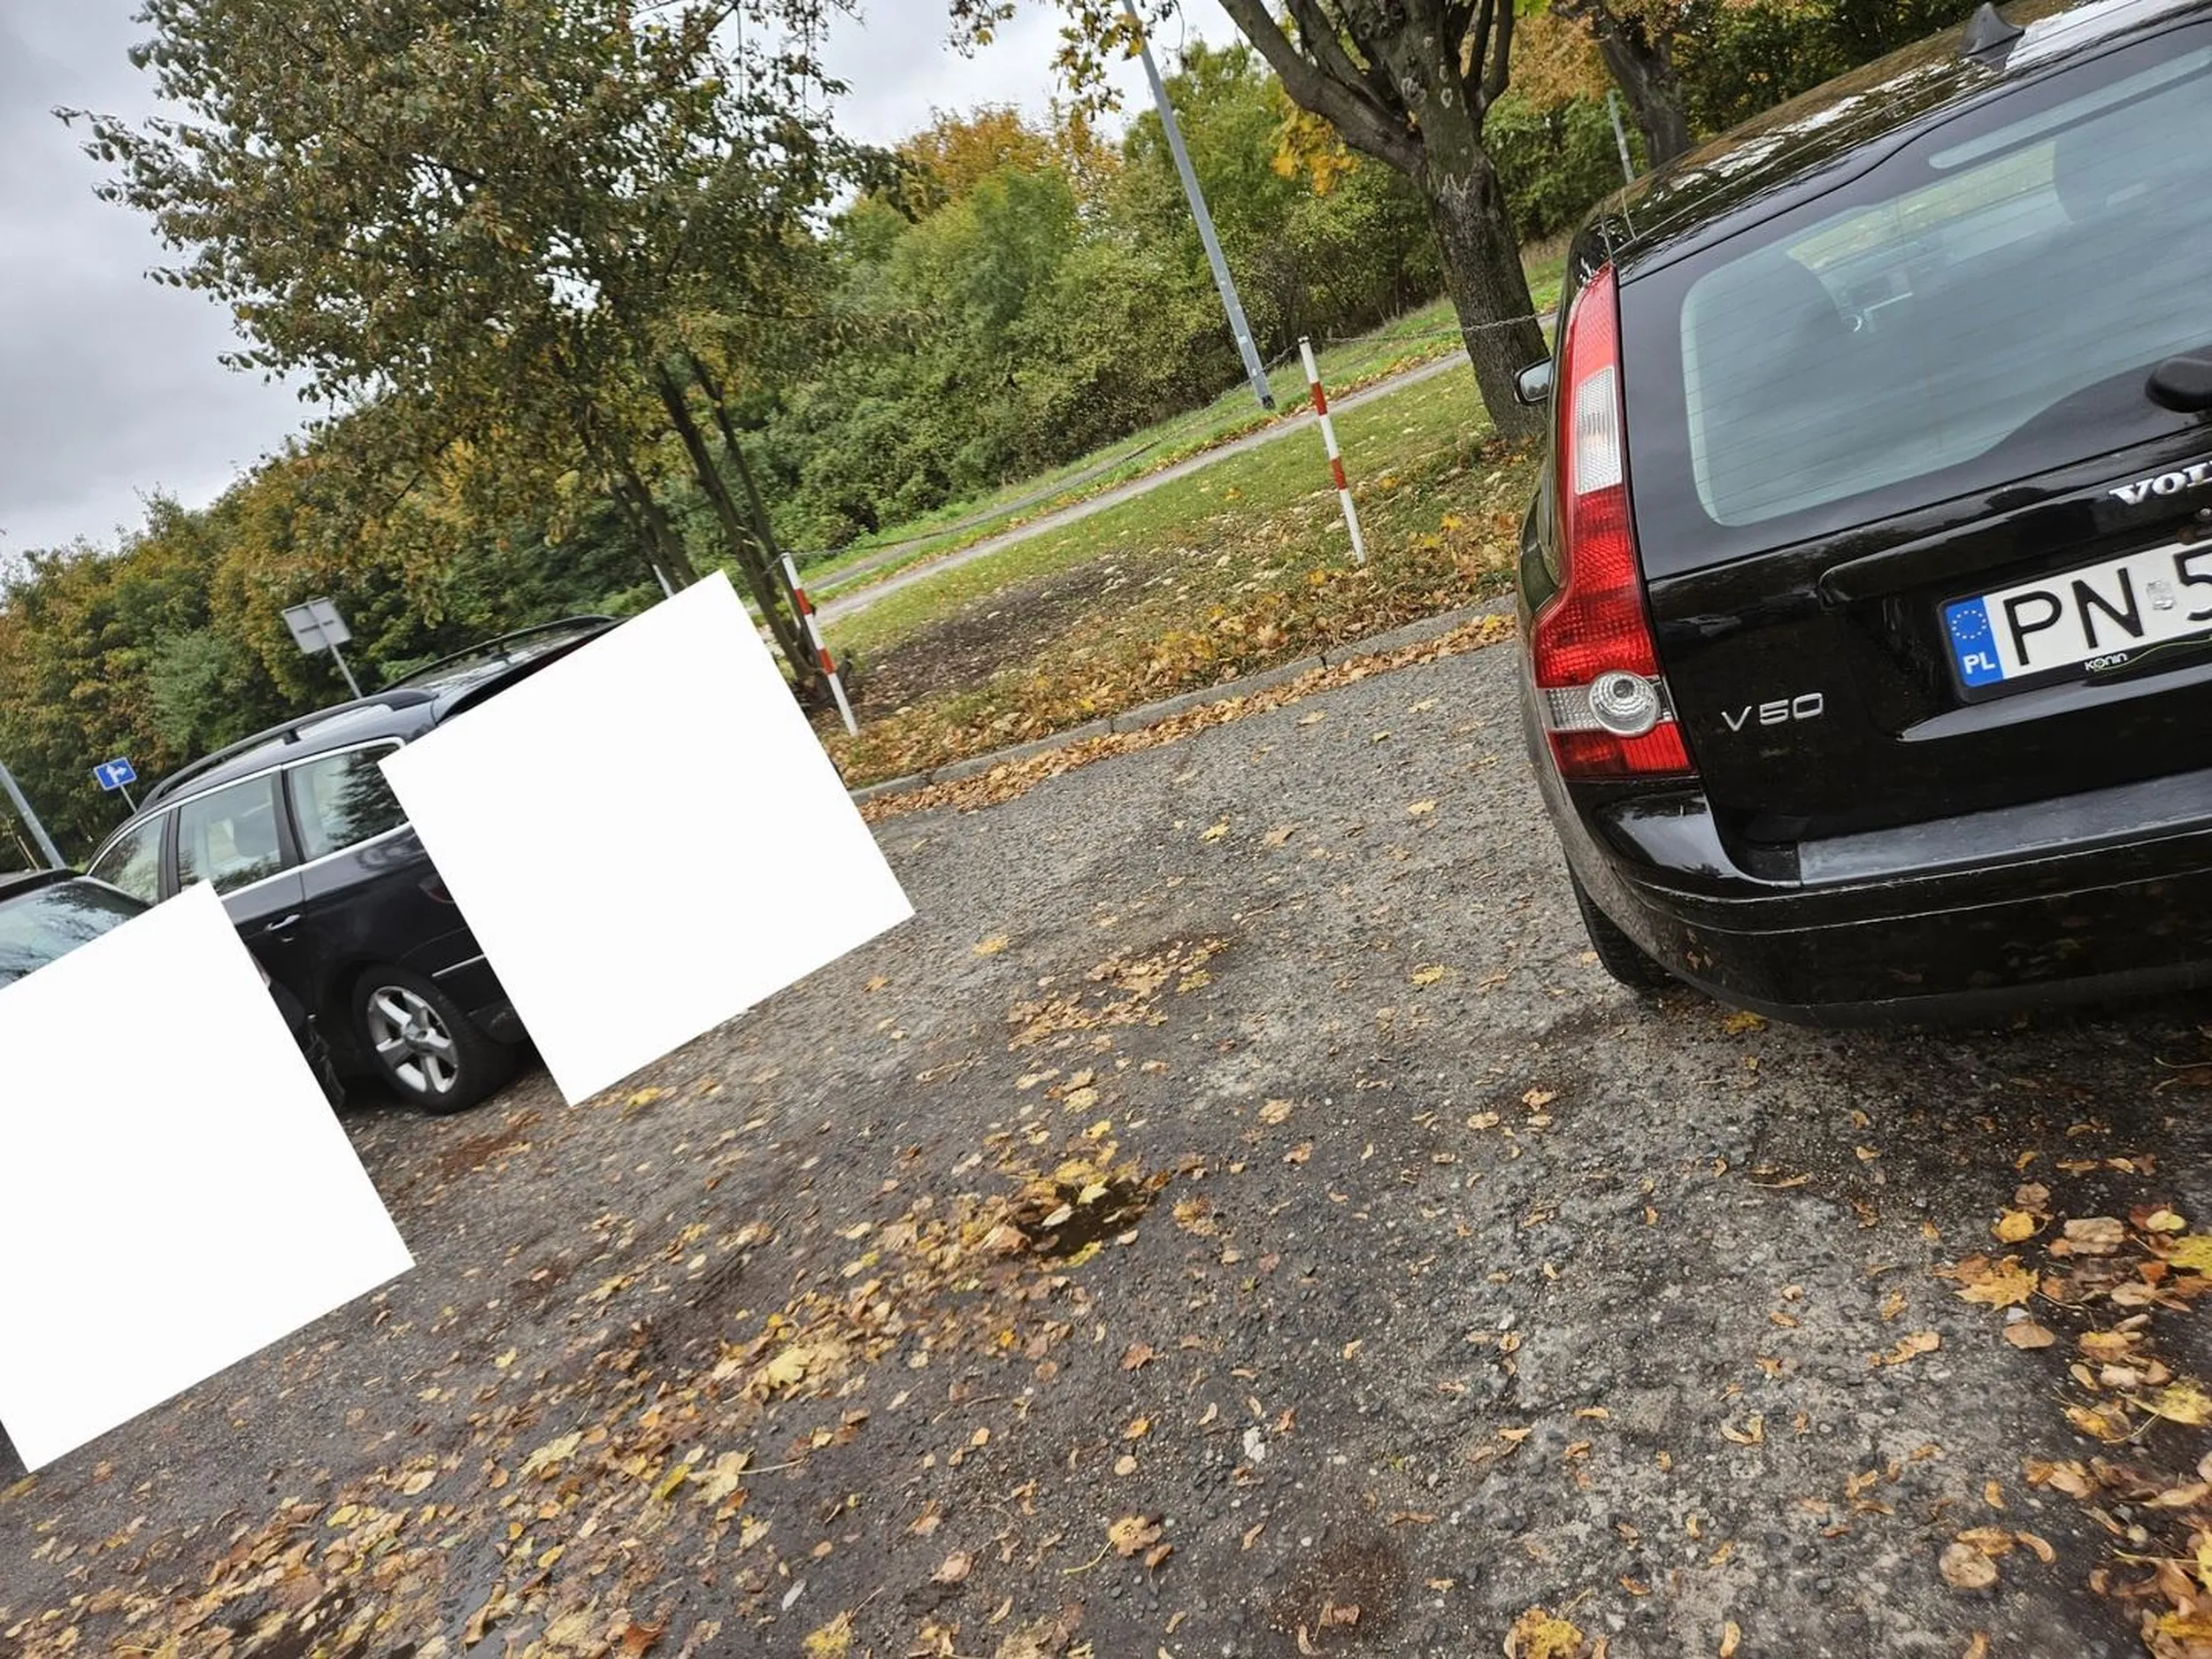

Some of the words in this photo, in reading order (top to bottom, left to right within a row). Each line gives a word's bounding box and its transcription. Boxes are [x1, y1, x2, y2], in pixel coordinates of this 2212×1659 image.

[2108, 460, 2212, 505] VOL
[2002, 567, 2145, 666] PN
[1962, 651, 1996, 674] PL
[1721, 692, 1824, 732] V50
